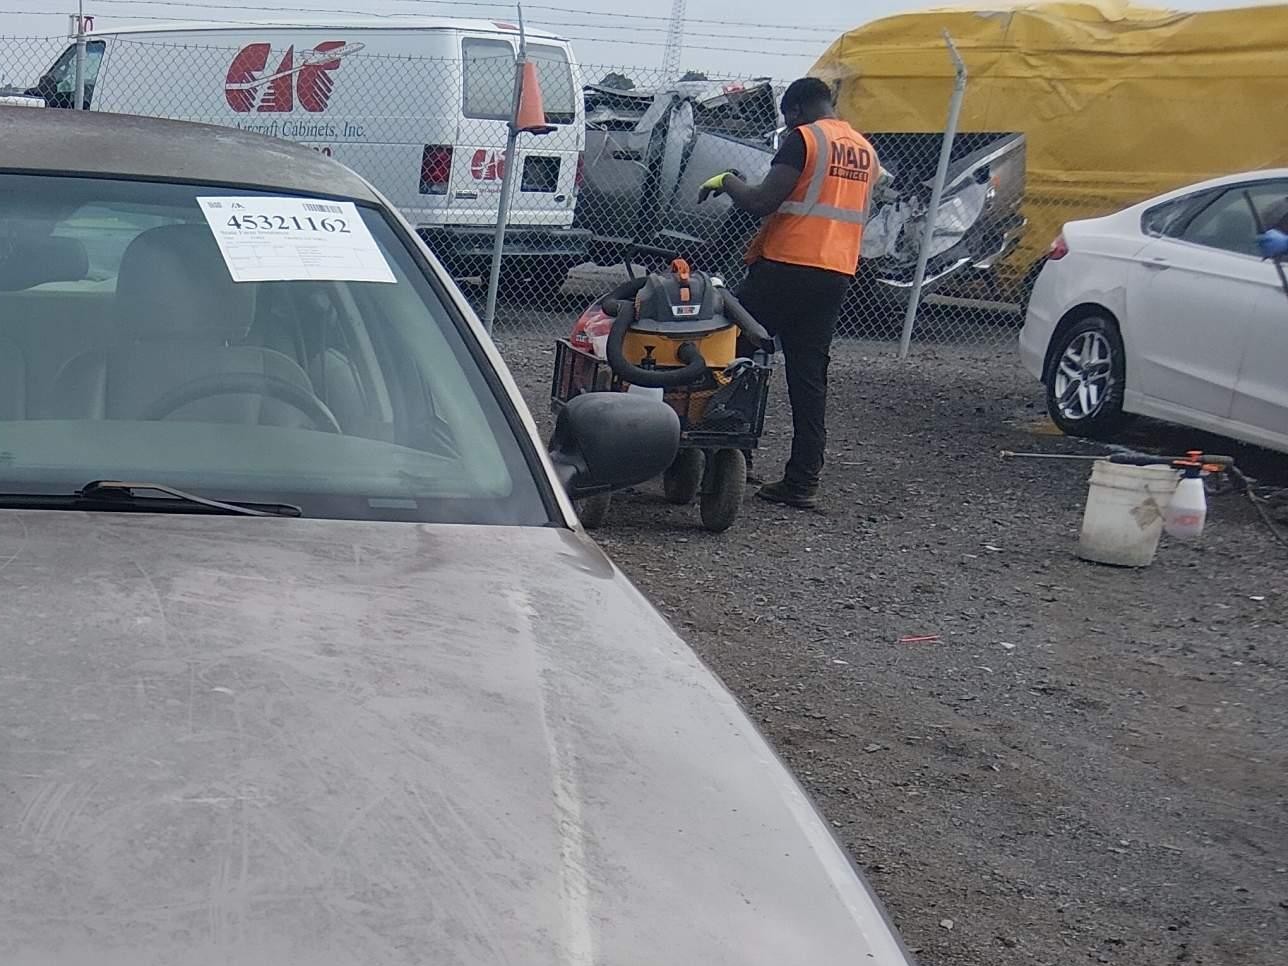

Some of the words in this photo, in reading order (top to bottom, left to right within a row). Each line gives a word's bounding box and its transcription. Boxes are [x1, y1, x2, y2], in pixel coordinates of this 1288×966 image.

[282, 121, 338, 138] Cabinets,
[343, 121, 367, 137] Inc.
[831, 141, 870, 170] MAD
[227, 215, 351, 233] 45321162
